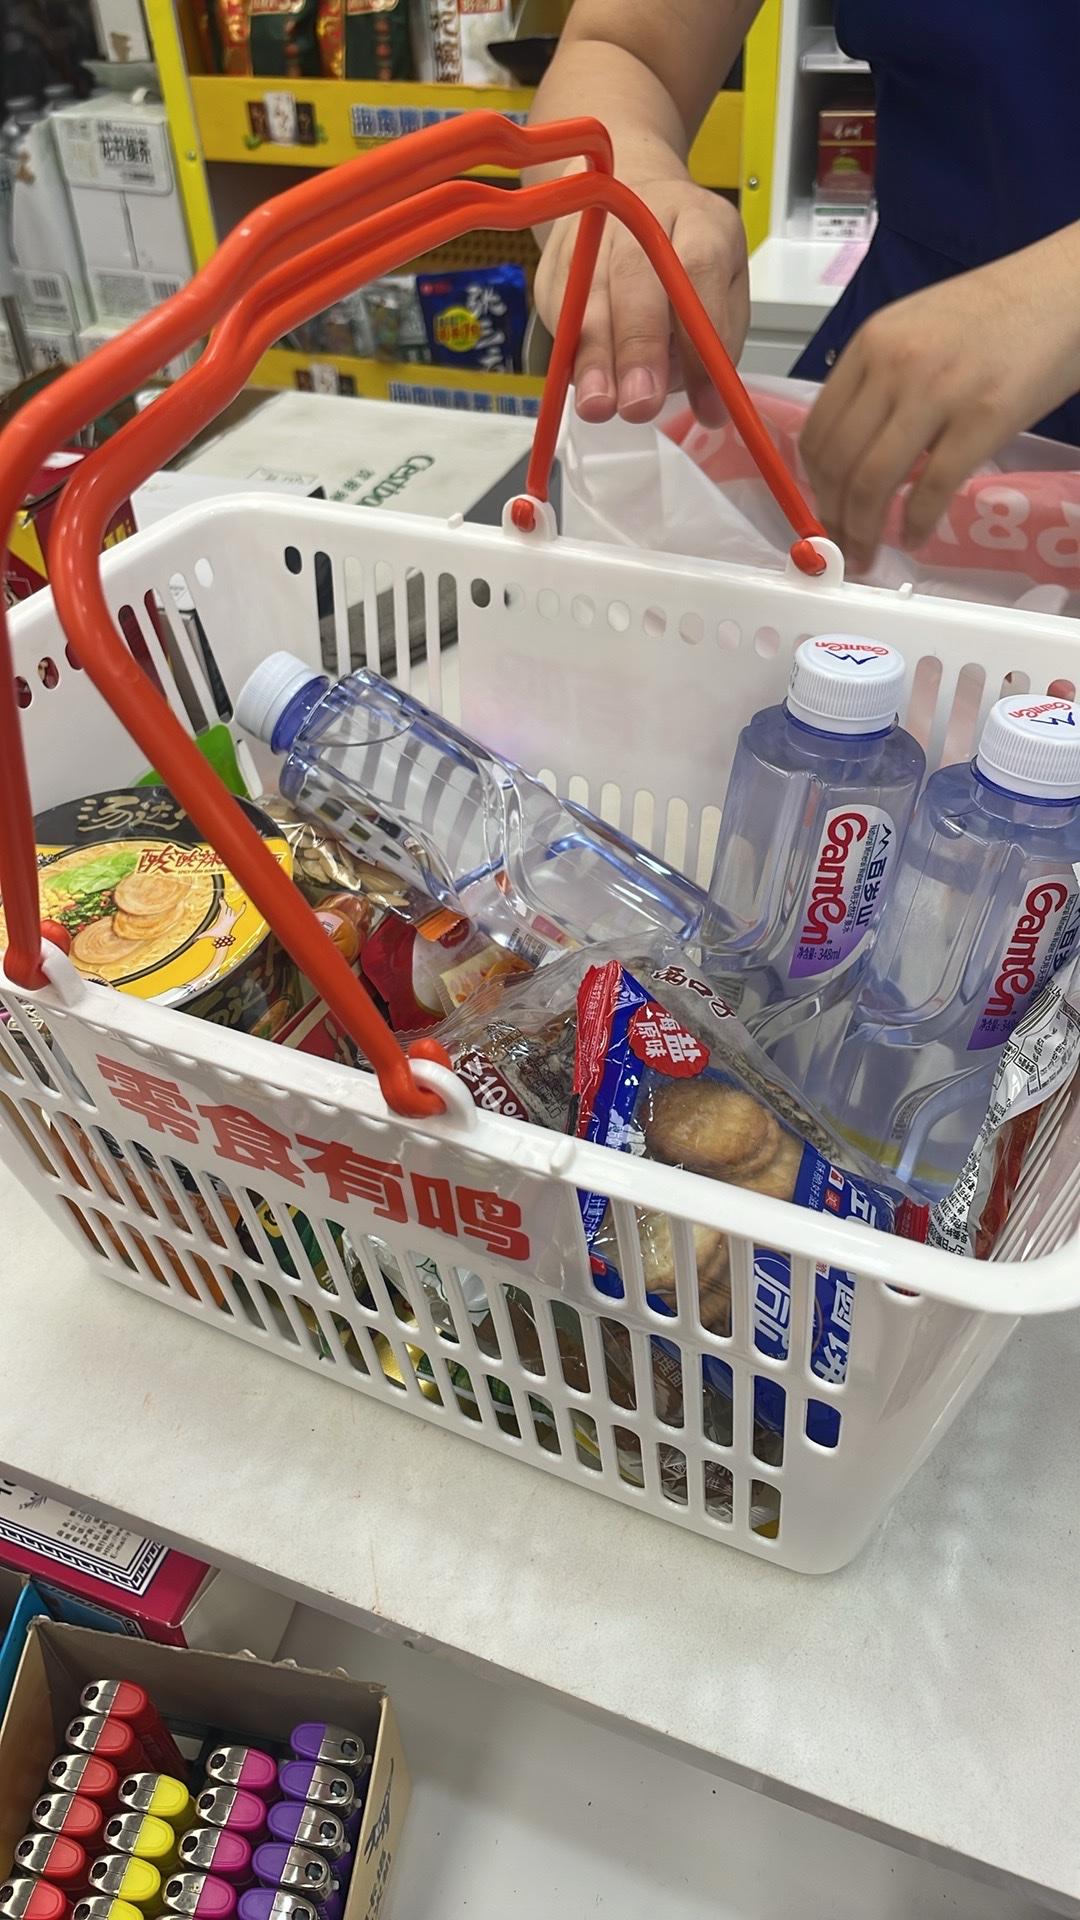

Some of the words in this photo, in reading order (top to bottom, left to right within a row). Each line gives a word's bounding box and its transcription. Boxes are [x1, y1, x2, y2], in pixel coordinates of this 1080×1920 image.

[800, 812, 869, 945] Ganten
[856, 857, 888, 927] 百岁山
[984, 882, 1068, 1017] Ganten
[95, 1053, 530, 1261] 零食有鸣
